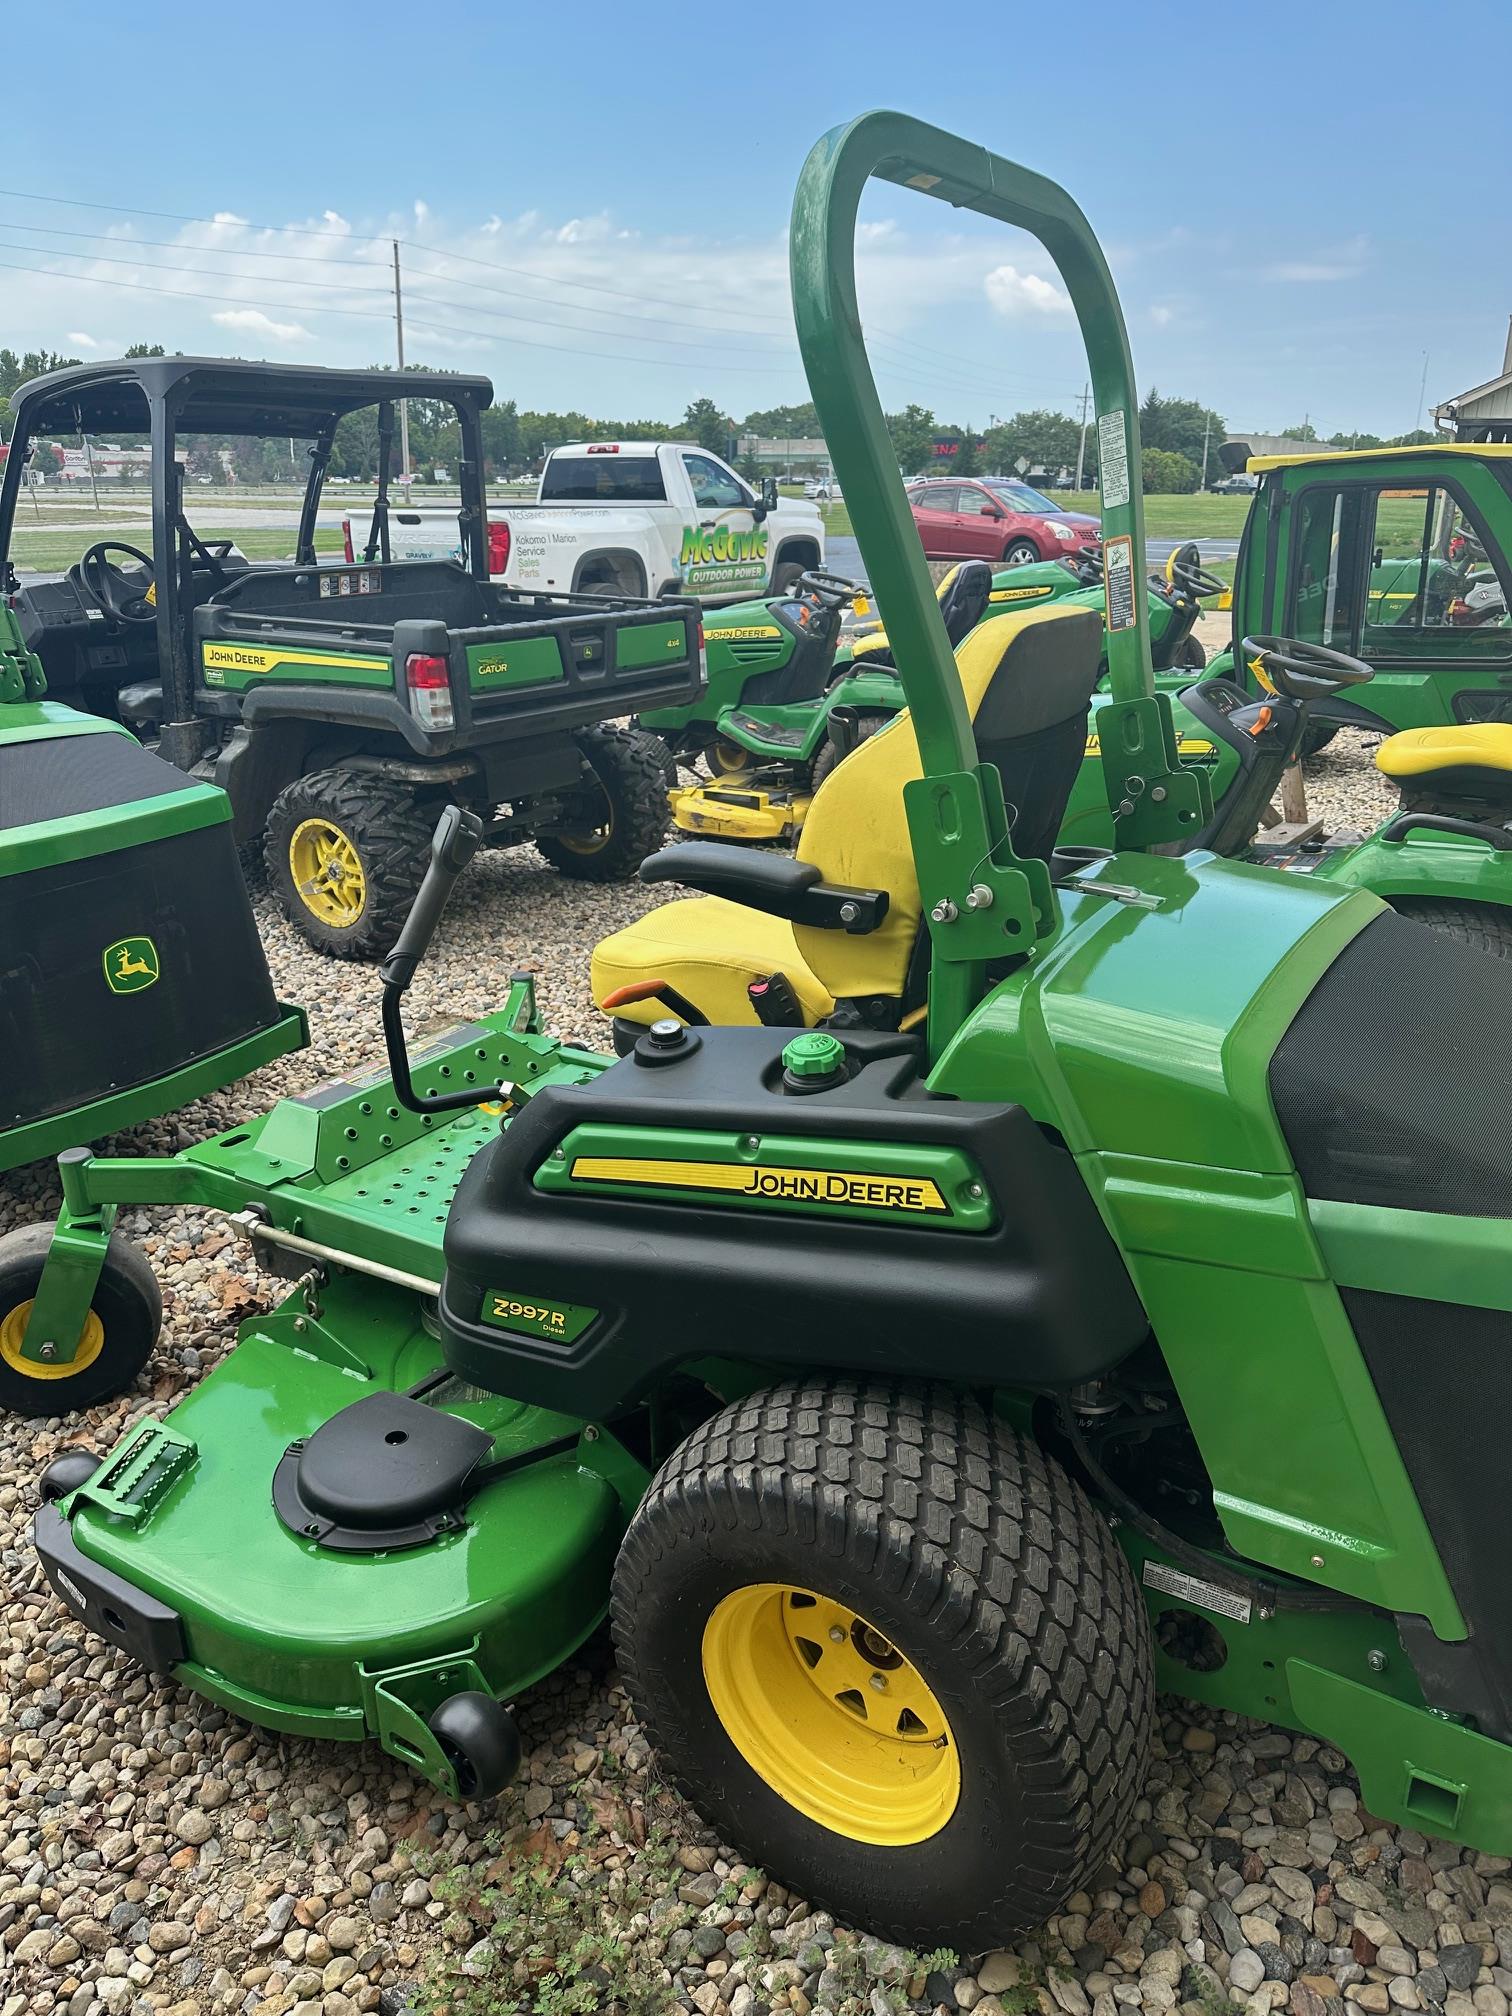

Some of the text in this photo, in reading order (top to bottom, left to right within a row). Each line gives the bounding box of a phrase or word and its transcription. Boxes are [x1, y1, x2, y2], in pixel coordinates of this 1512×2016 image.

[515, 535, 547, 545] Kokomo
[552, 533, 577, 543] Marion
[516, 547, 546, 556] Service
[518, 558, 540, 568] Sales
[519, 569, 540, 578] Parts
[693, 566, 762, 582] OUTDOOR POWER
[708, 629, 767, 639] JOHN DEERE
[209, 649, 266, 666] JOHN DEERE
[478, 663, 508, 675] GATOR
[744, 1169, 925, 1208] JOHN DEERE
[493, 1297, 566, 1327] Z997R
[542, 1324, 566, 1335] Diesel
